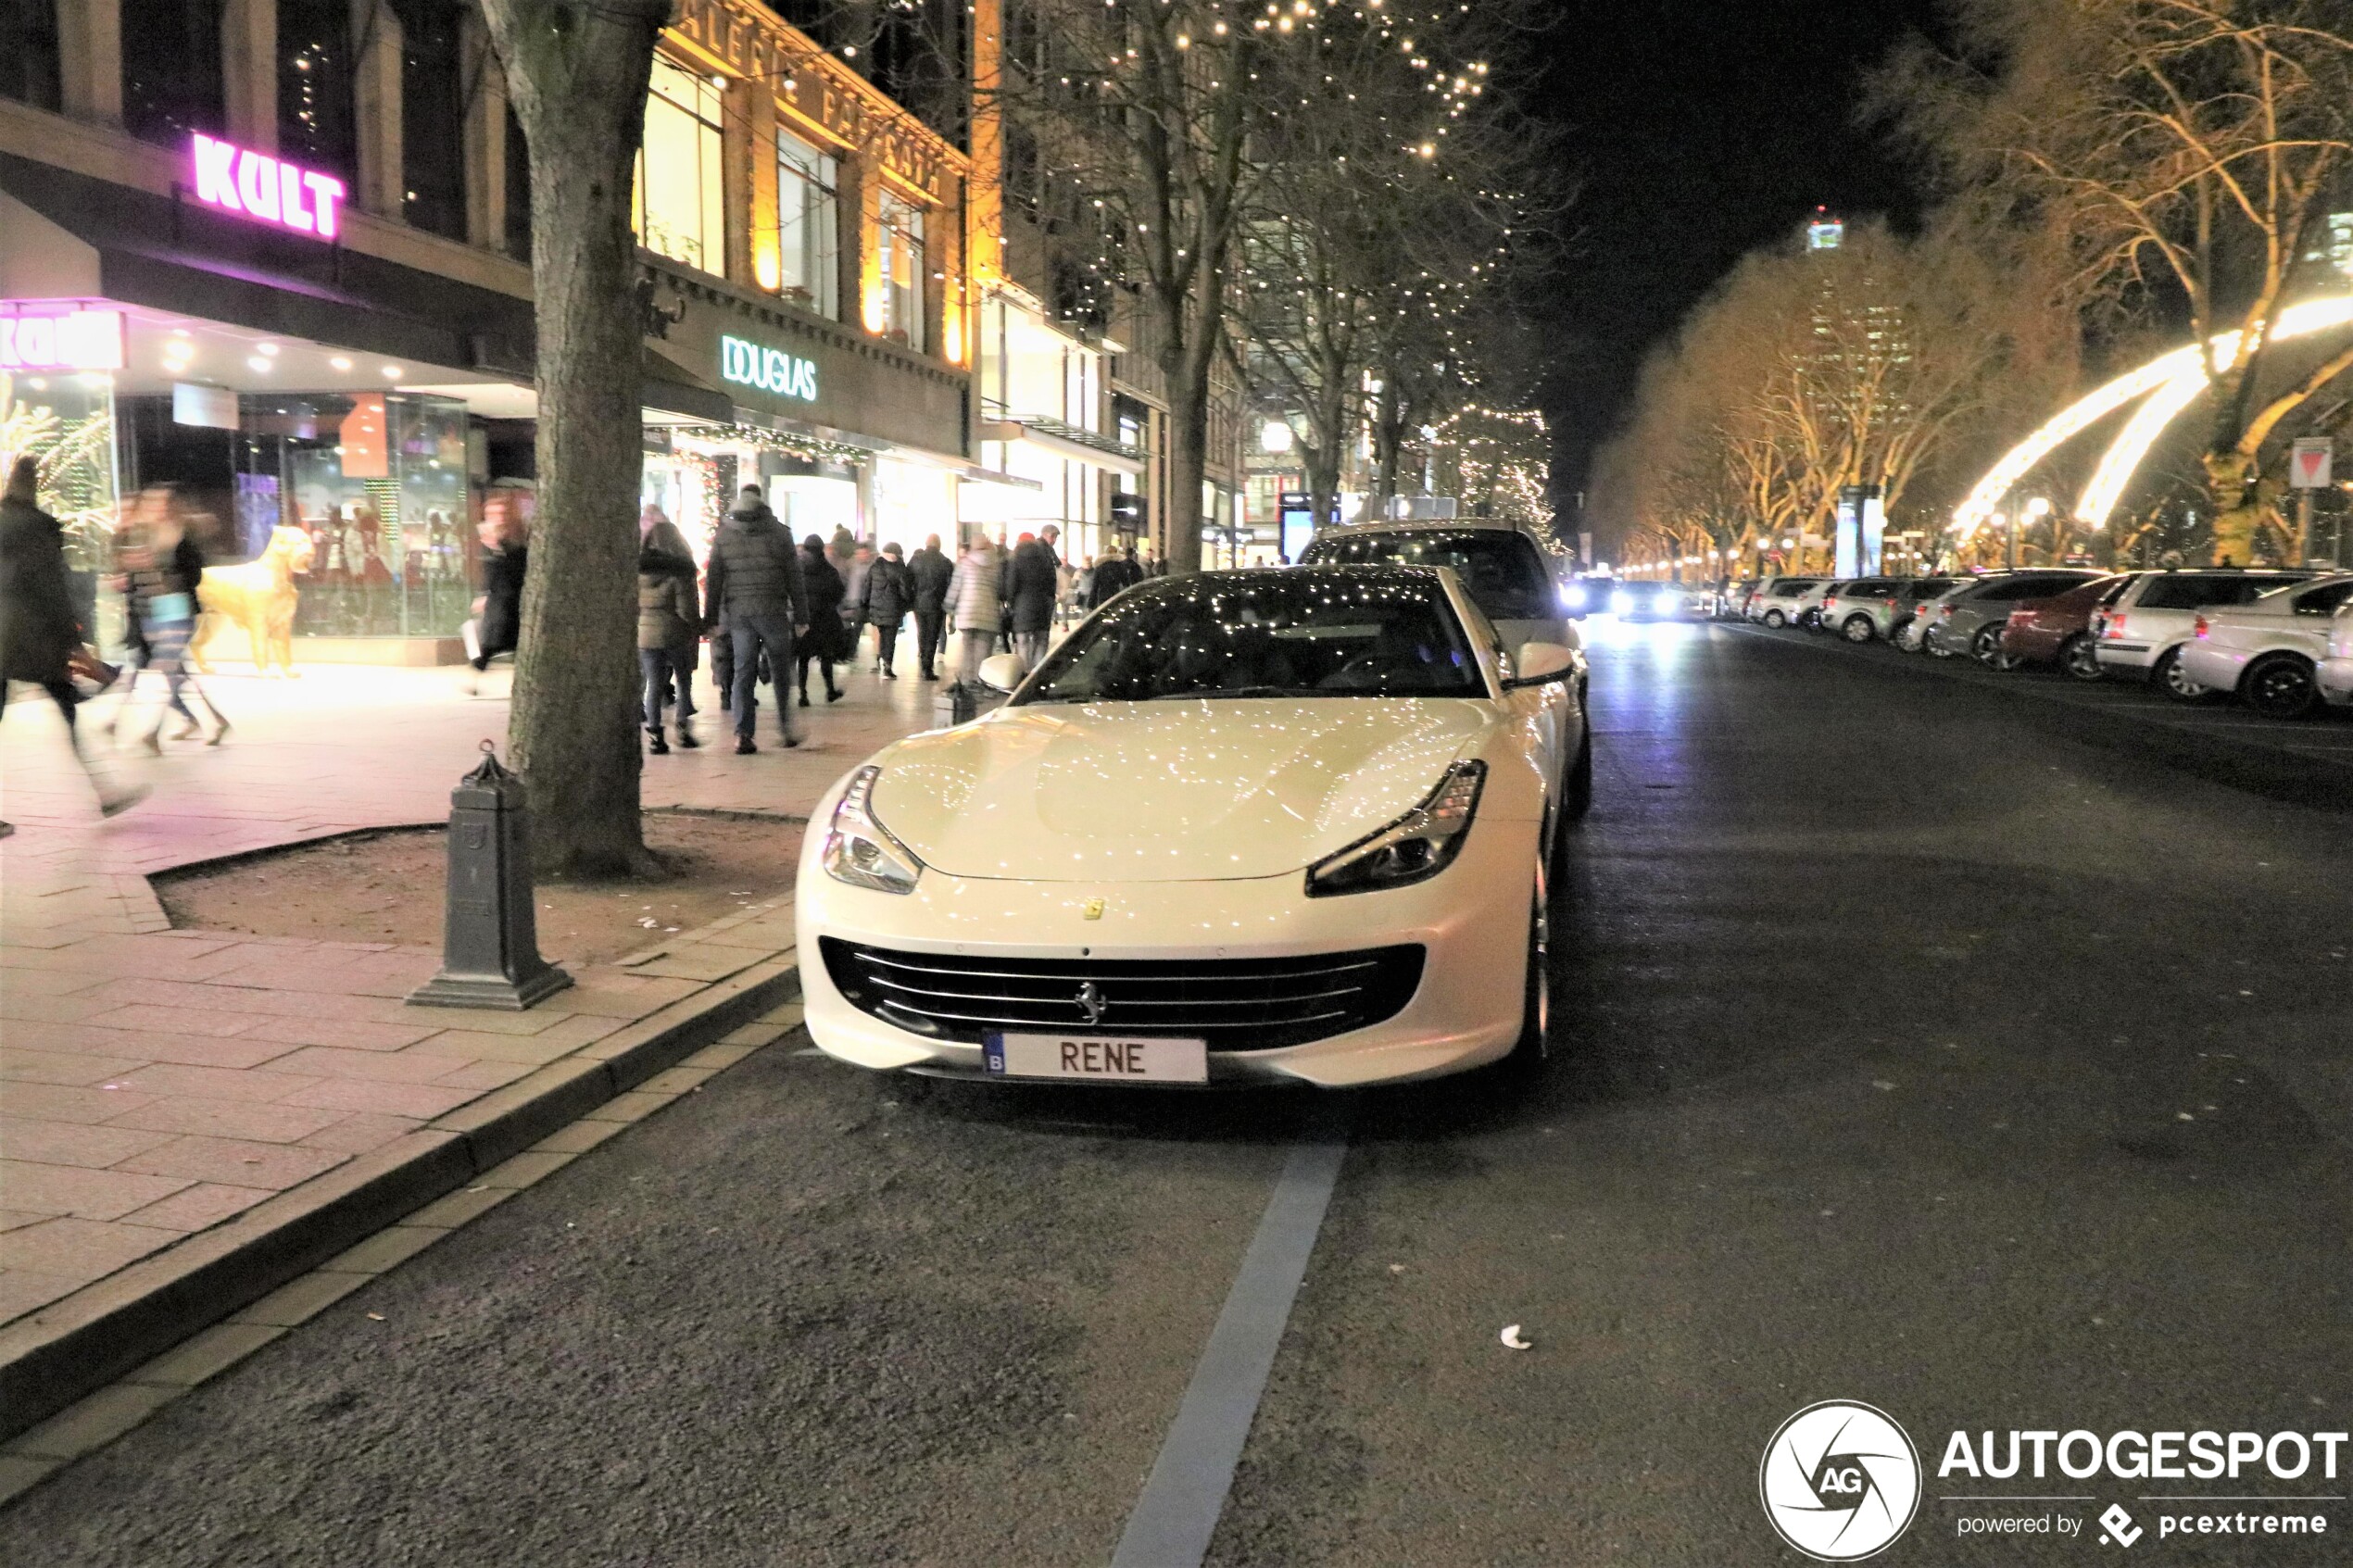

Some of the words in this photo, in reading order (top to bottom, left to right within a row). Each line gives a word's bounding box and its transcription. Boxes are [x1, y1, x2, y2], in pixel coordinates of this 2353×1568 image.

[194, 133, 344, 237] KULT
[723, 335, 816, 401] DOUGLAS
[989, 1055, 1002, 1070] B
[1061, 1041, 1145, 1073] RENE
